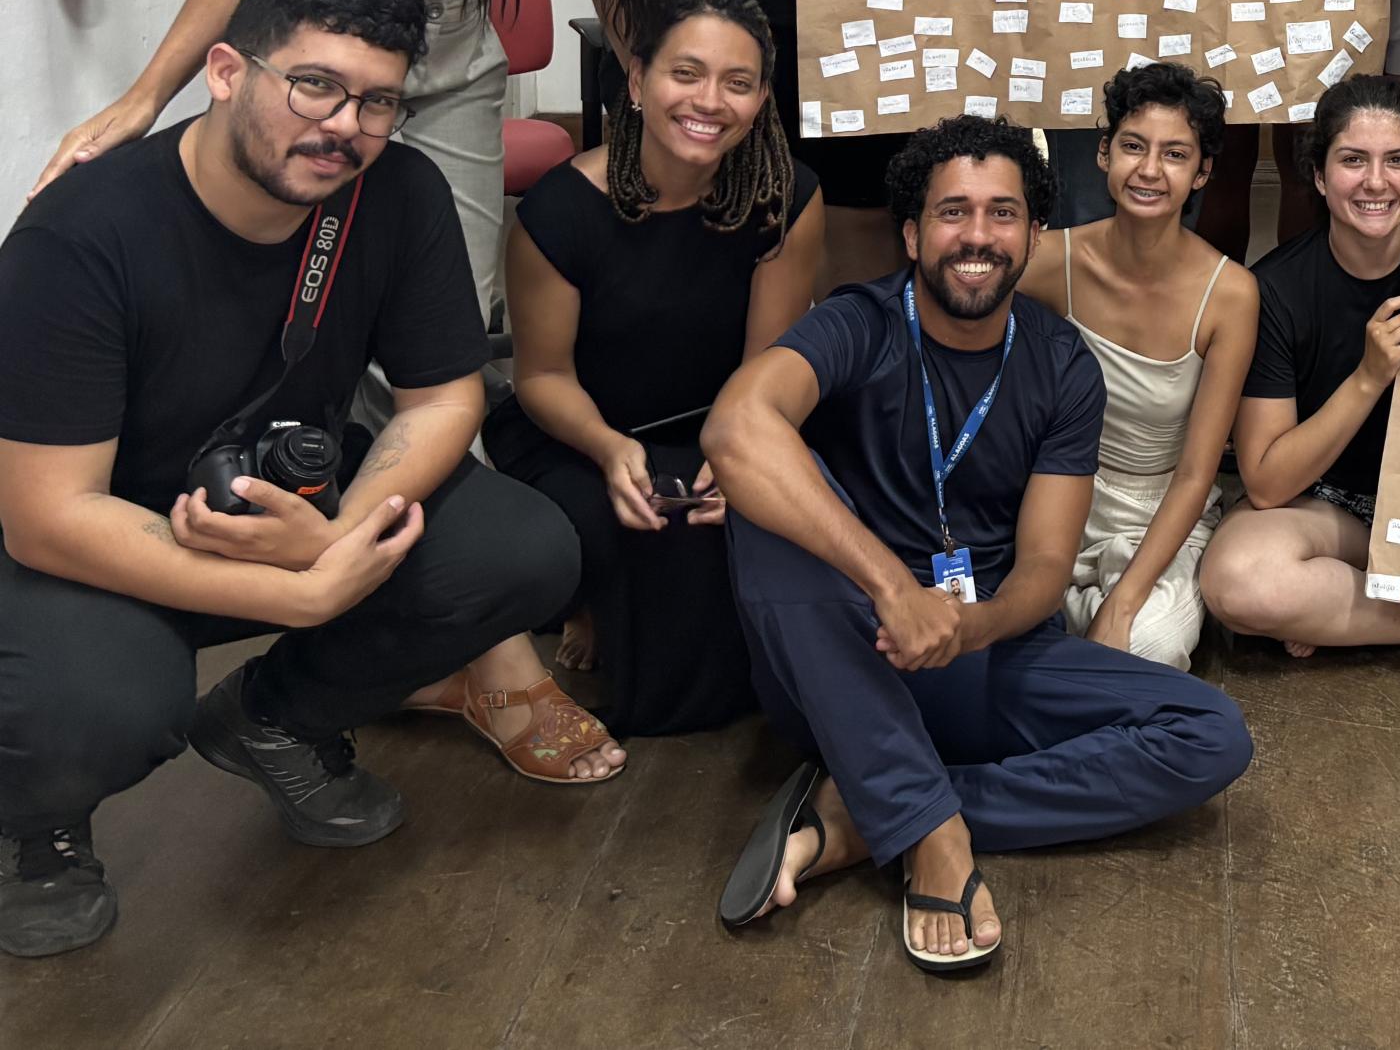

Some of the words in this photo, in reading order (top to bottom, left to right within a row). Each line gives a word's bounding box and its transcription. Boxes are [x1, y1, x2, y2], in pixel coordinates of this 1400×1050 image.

[301, 253, 329, 303] EOS
[316, 216, 340, 251] 80D
[950, 432, 970, 462] ALAGOAS
